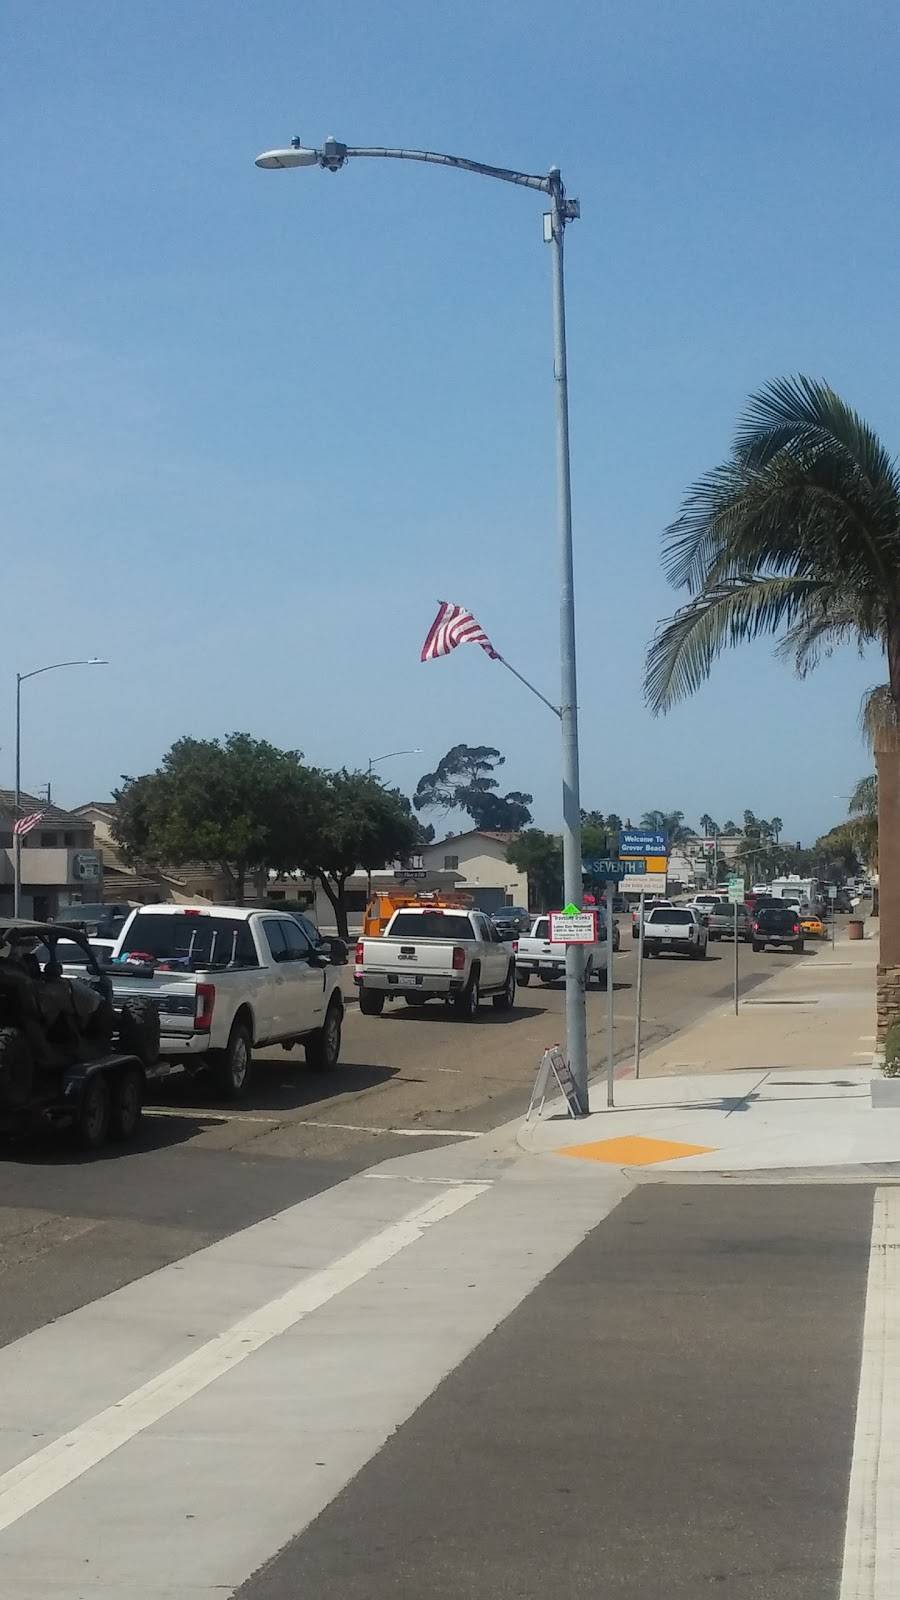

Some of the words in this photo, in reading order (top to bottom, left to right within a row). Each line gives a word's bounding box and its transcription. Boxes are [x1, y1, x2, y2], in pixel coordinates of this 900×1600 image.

[624, 835, 654, 843] Welcome
[655, 835, 665, 843] To
[645, 844, 666, 852] Beach
[593, 860, 636, 873] SEVENTH
